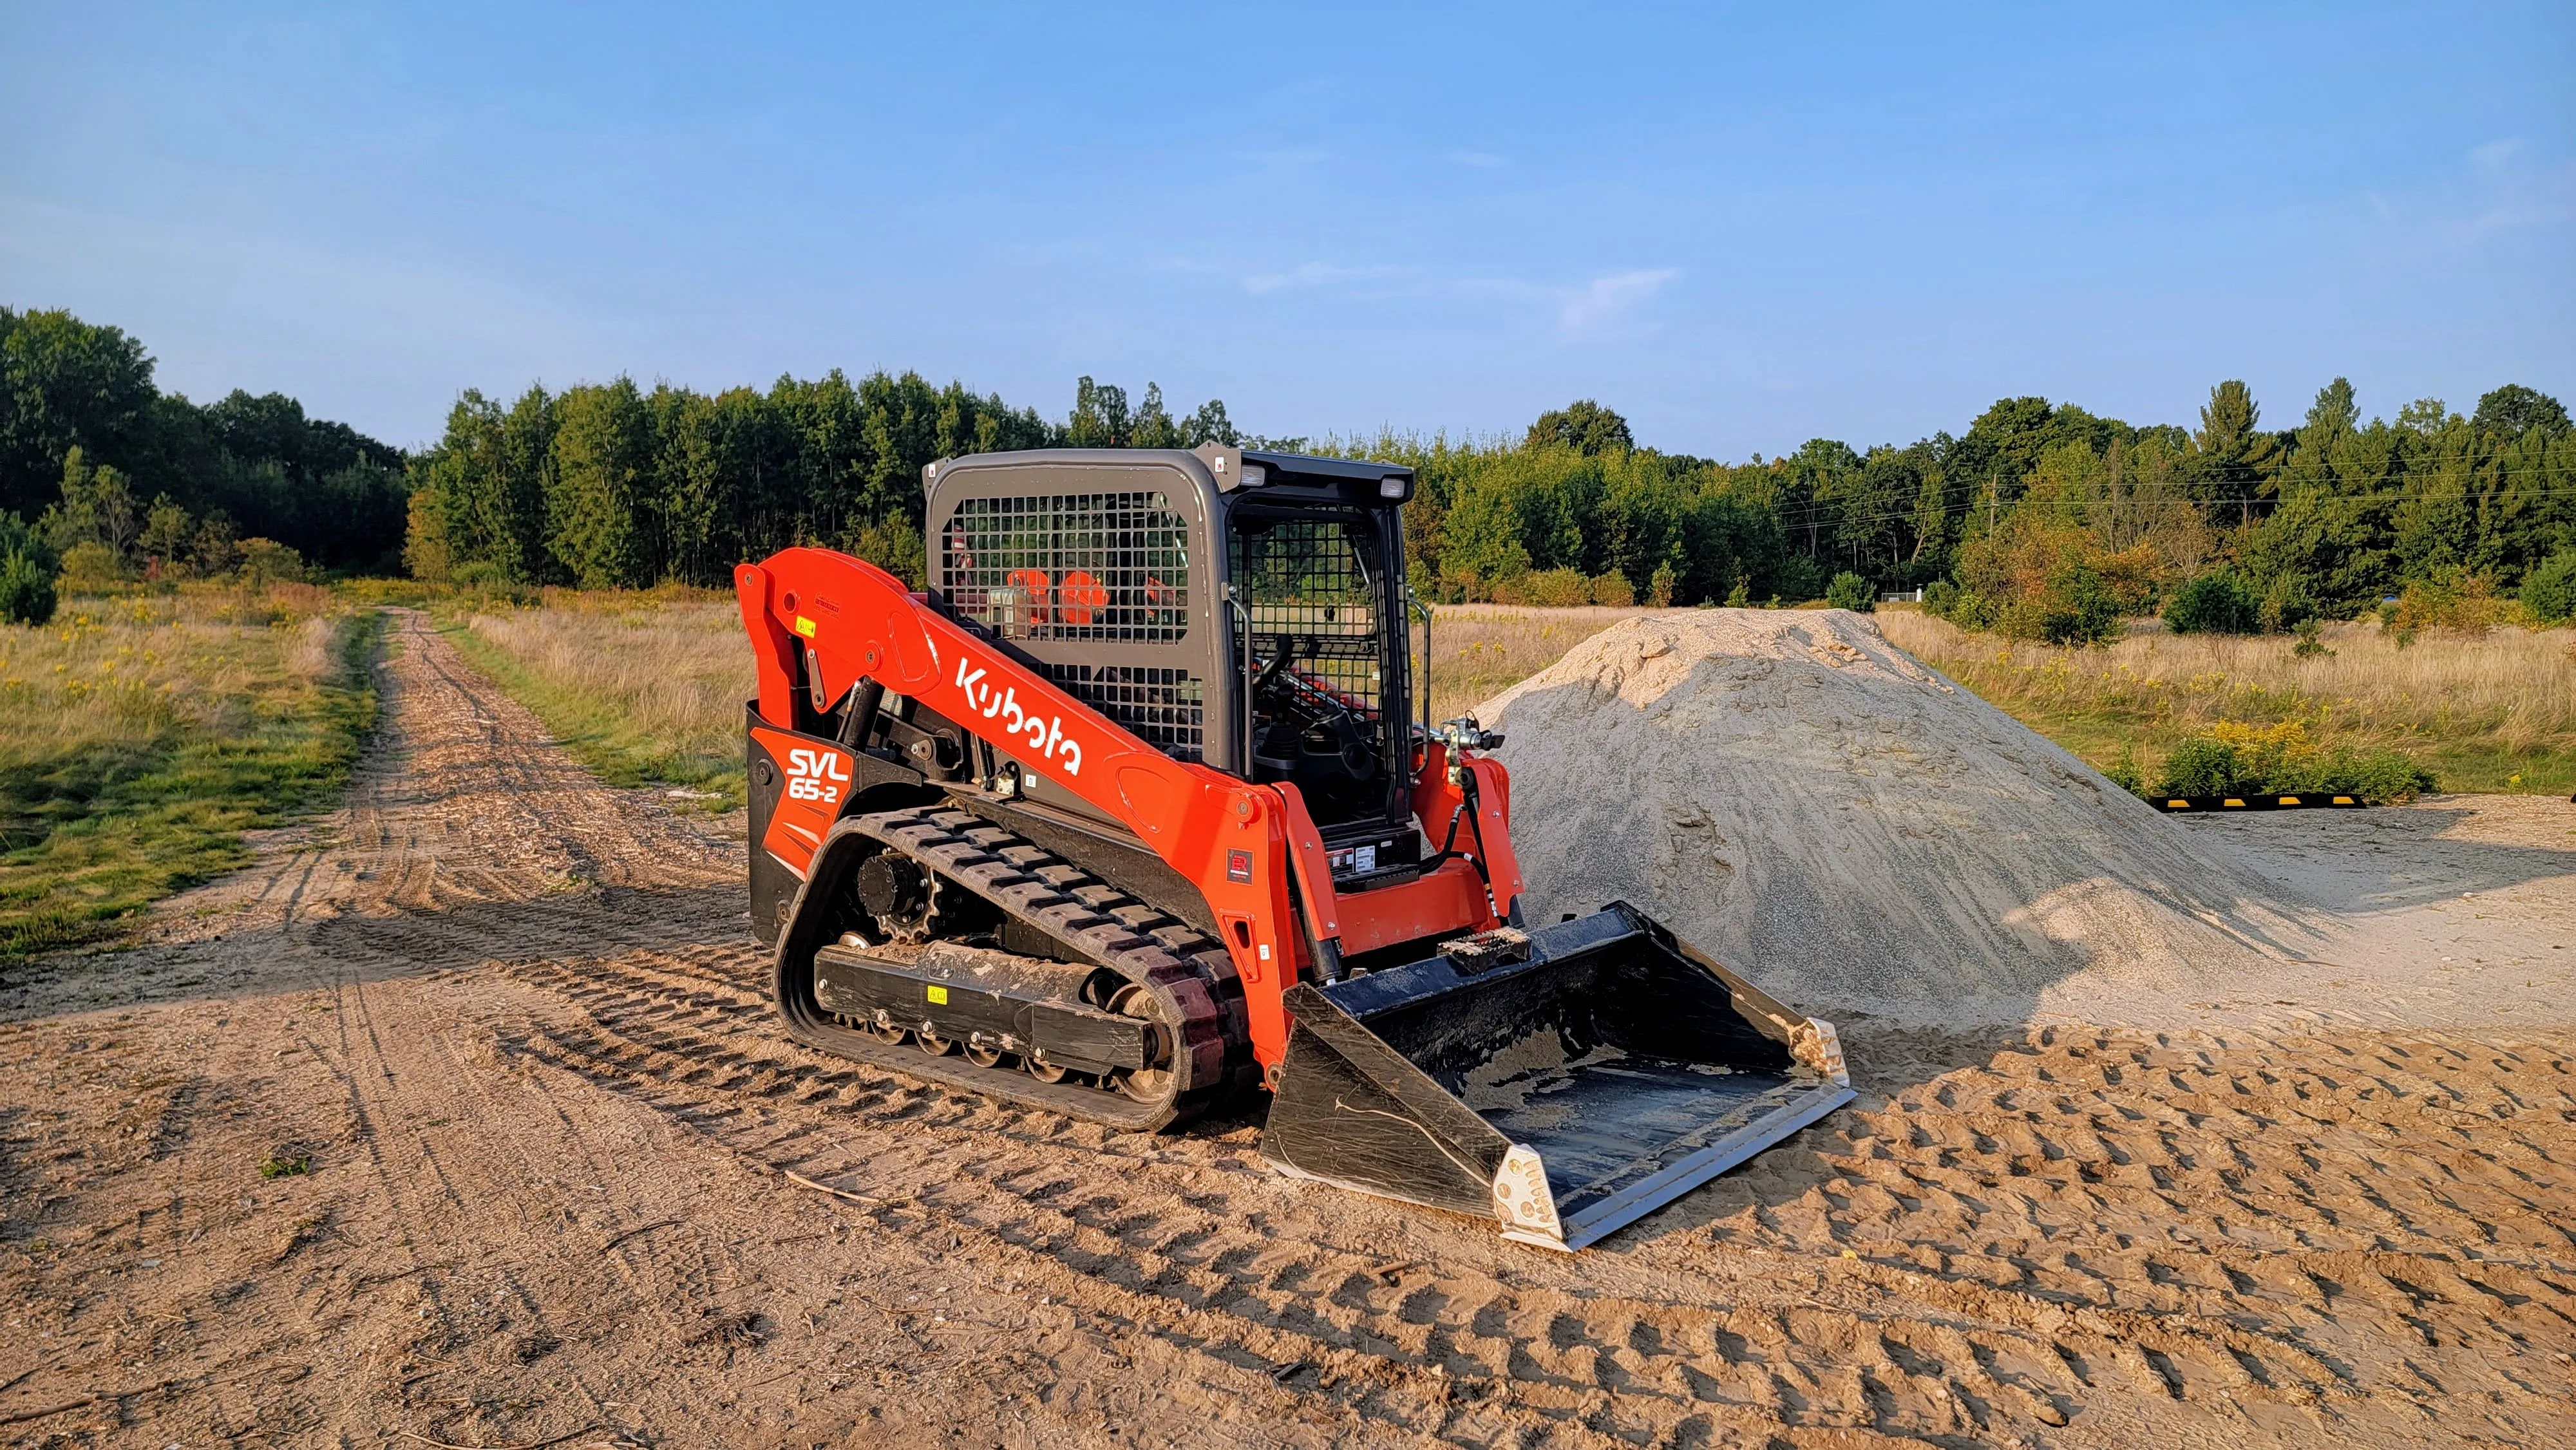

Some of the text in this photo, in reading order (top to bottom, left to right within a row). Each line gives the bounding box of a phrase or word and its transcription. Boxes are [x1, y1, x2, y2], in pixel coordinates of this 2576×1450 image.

[956, 657, 1081, 776] Kubota
[787, 749, 848, 781] SVL
[789, 777, 837, 803] 65-2
